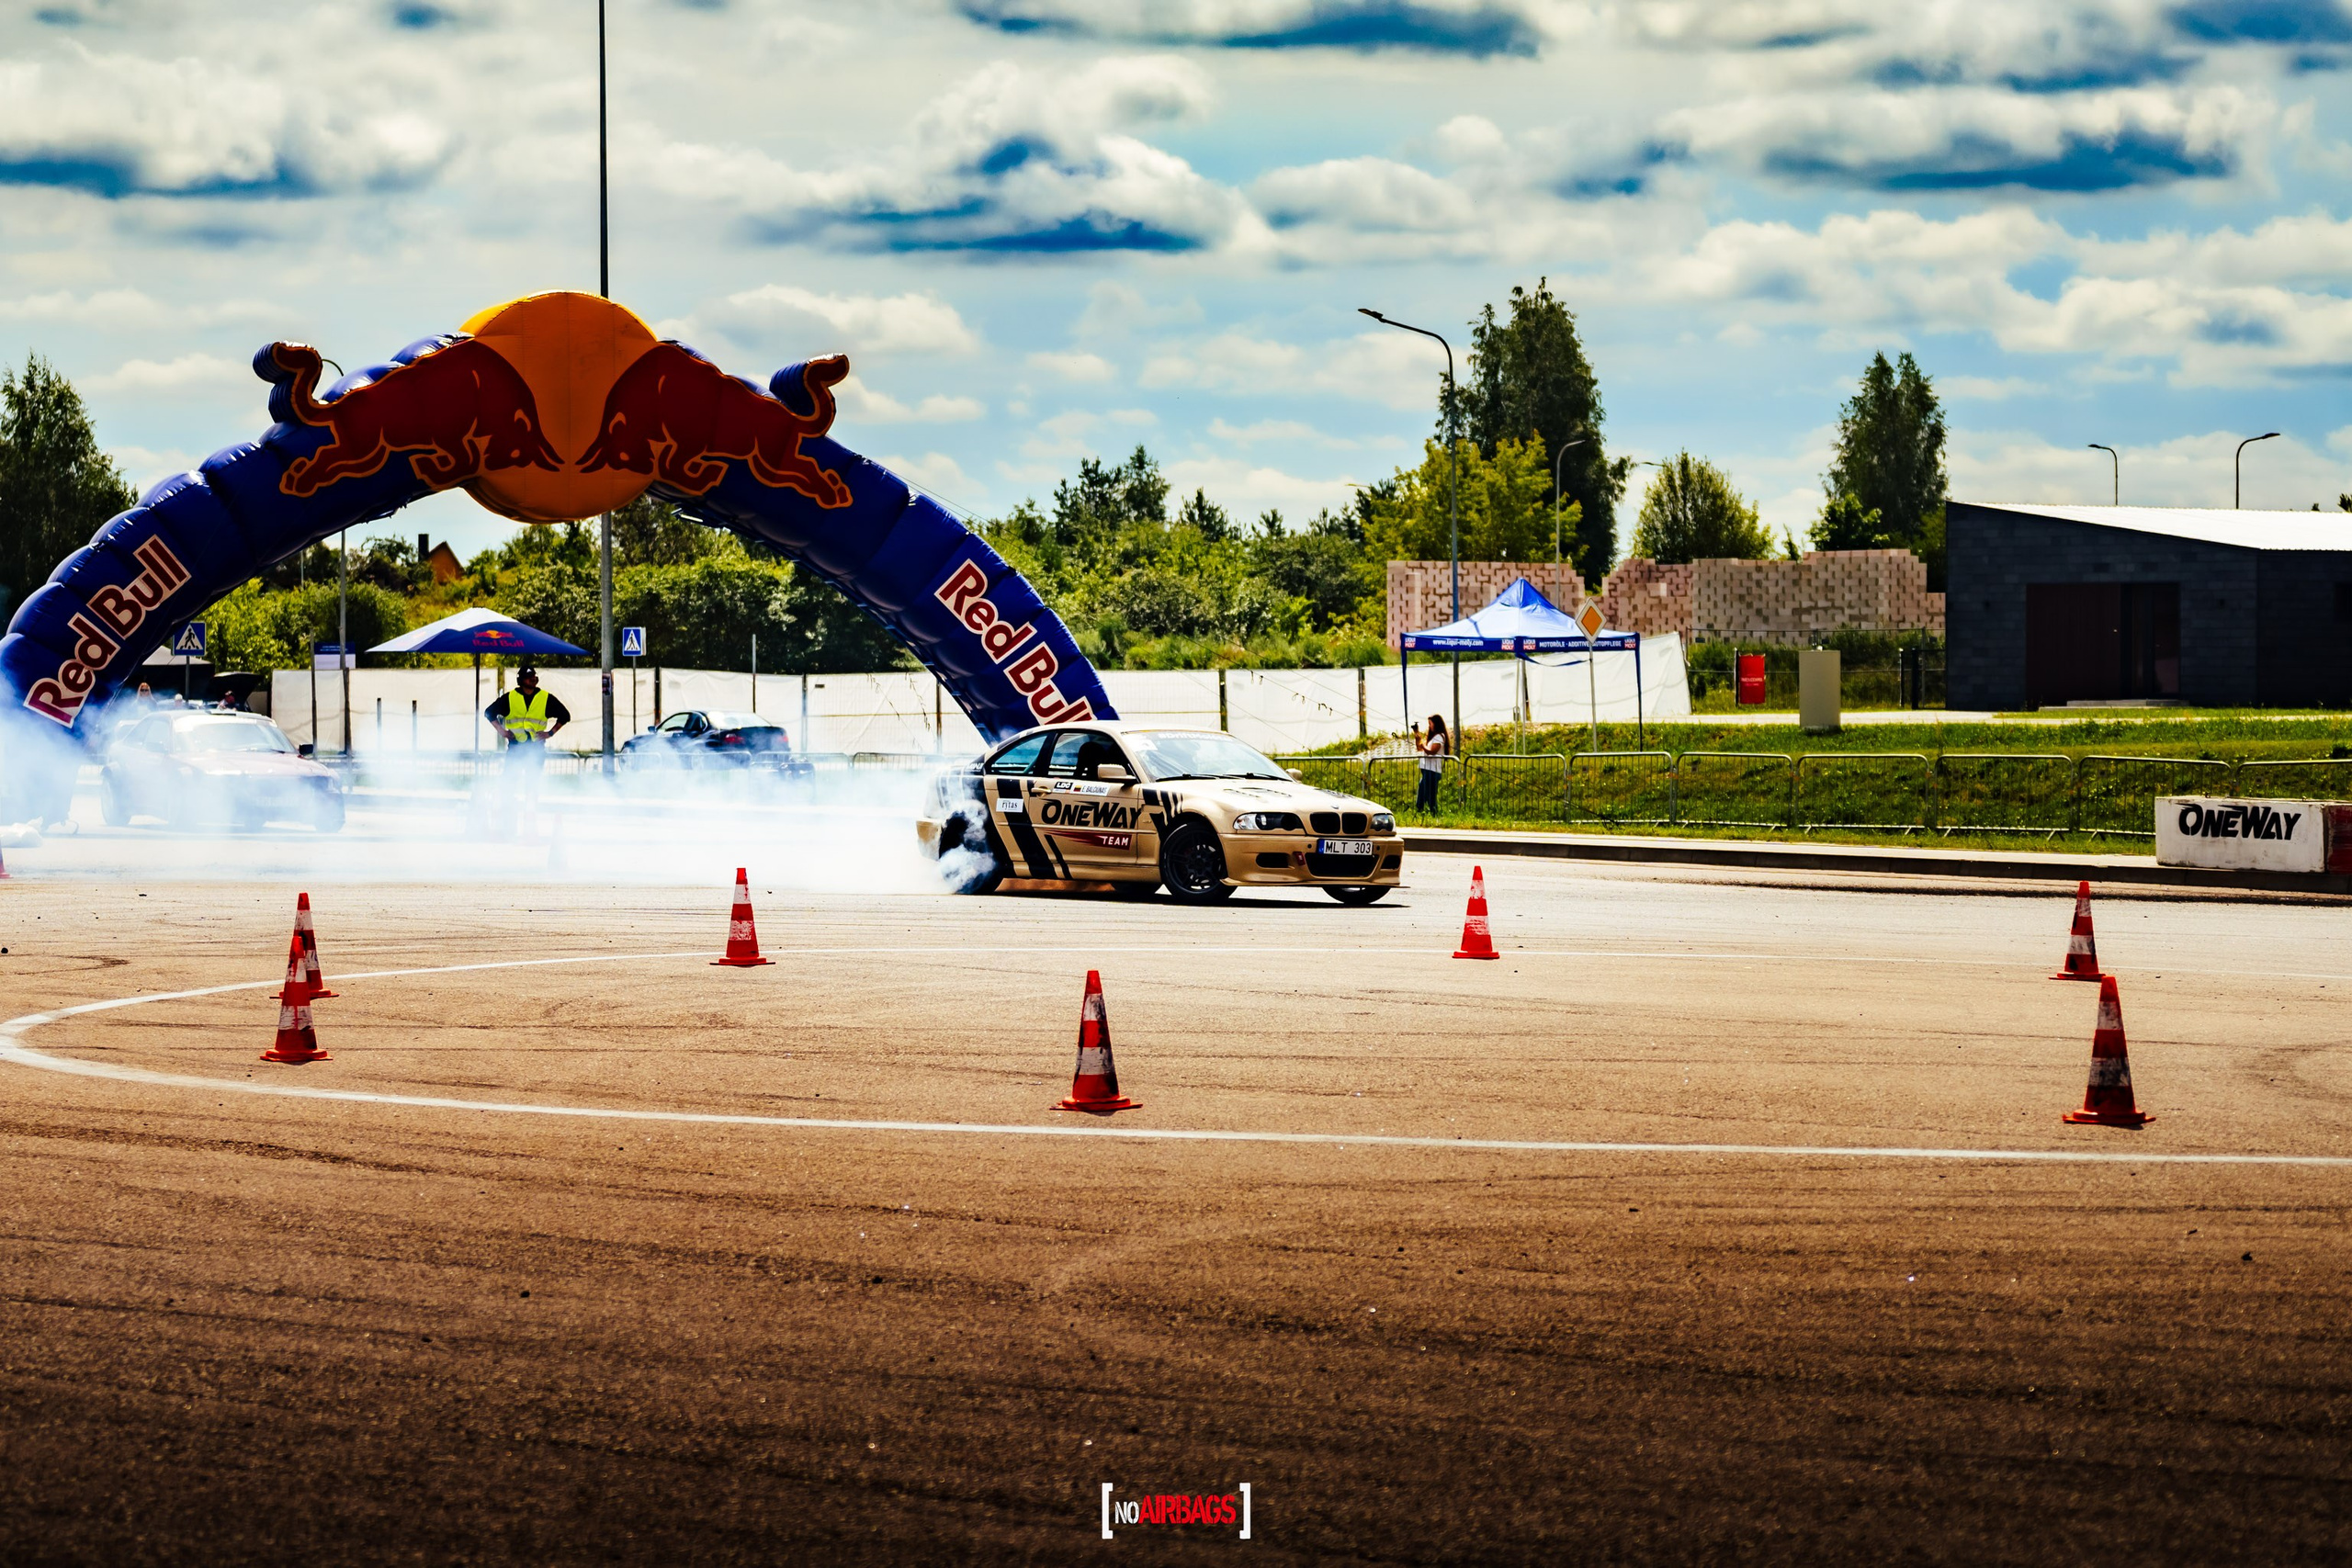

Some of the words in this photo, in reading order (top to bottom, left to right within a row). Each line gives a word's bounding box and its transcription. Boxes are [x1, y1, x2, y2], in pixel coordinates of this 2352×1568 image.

[933, 558, 1038, 665] Red
[23, 612, 120, 728] Red
[86, 534, 192, 640] Bull
[499, 639, 525, 648] Bull
[1101, 835, 1129, 846] TEAM
[1325, 841, 1348, 853] MLT
[1353, 842, 1371, 854] 303
